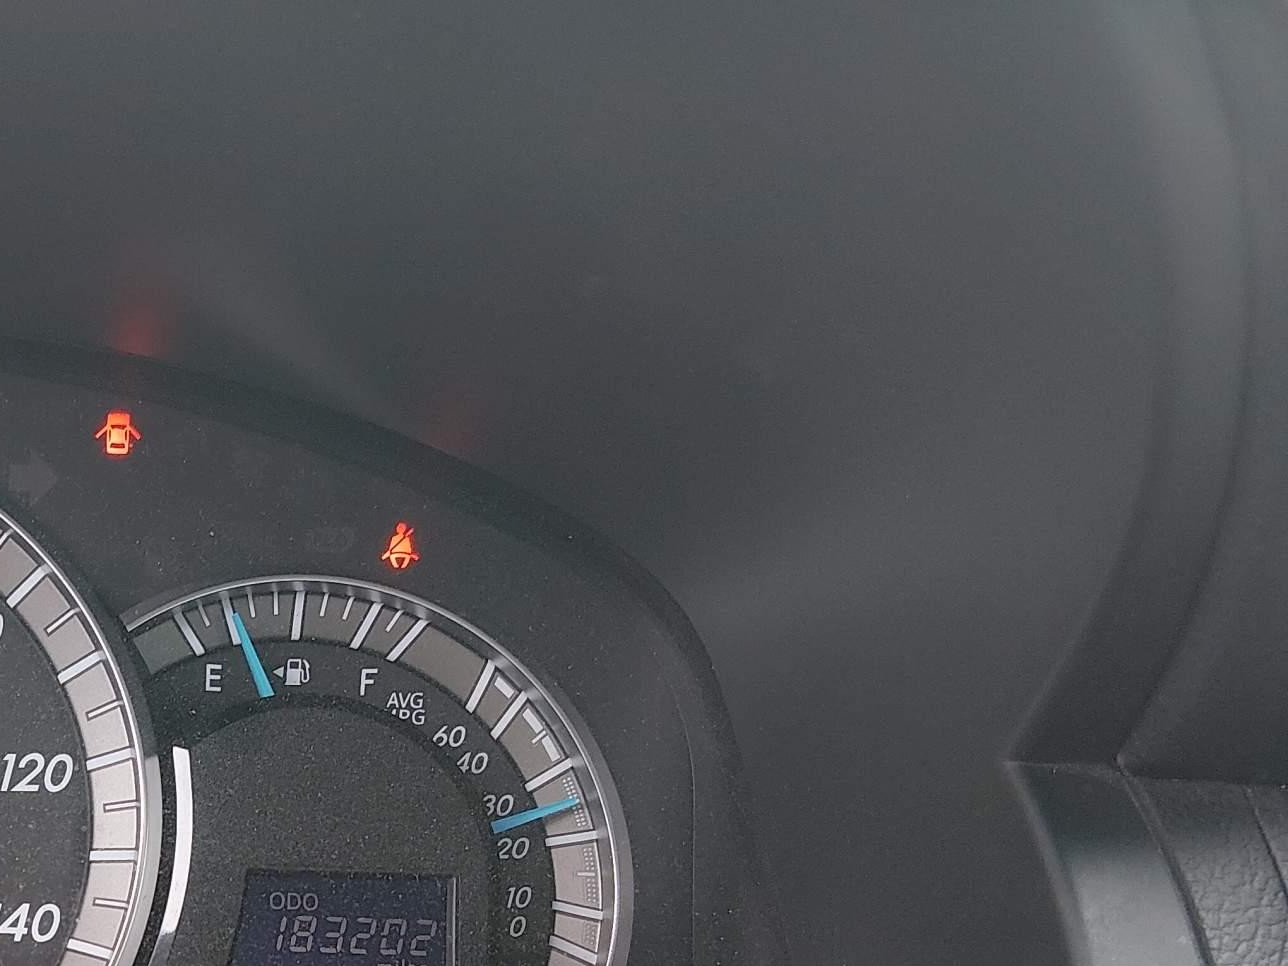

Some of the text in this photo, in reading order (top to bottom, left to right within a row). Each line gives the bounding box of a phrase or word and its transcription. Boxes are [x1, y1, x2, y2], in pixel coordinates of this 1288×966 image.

[206, 664, 221, 691] E
[361, 669, 377, 695] F
[386, 692, 423, 708] AVG
[433, 726, 465, 747] 60
[1, 753, 73, 792] 120
[457, 752, 488, 773] 40
[484, 795, 513, 816] 30
[498, 838, 529, 858] 20
[270, 892, 318, 911] ODO
[508, 887, 531, 908] 10
[277, 916, 436, 955] 183202
[510, 917, 526, 937] 0
